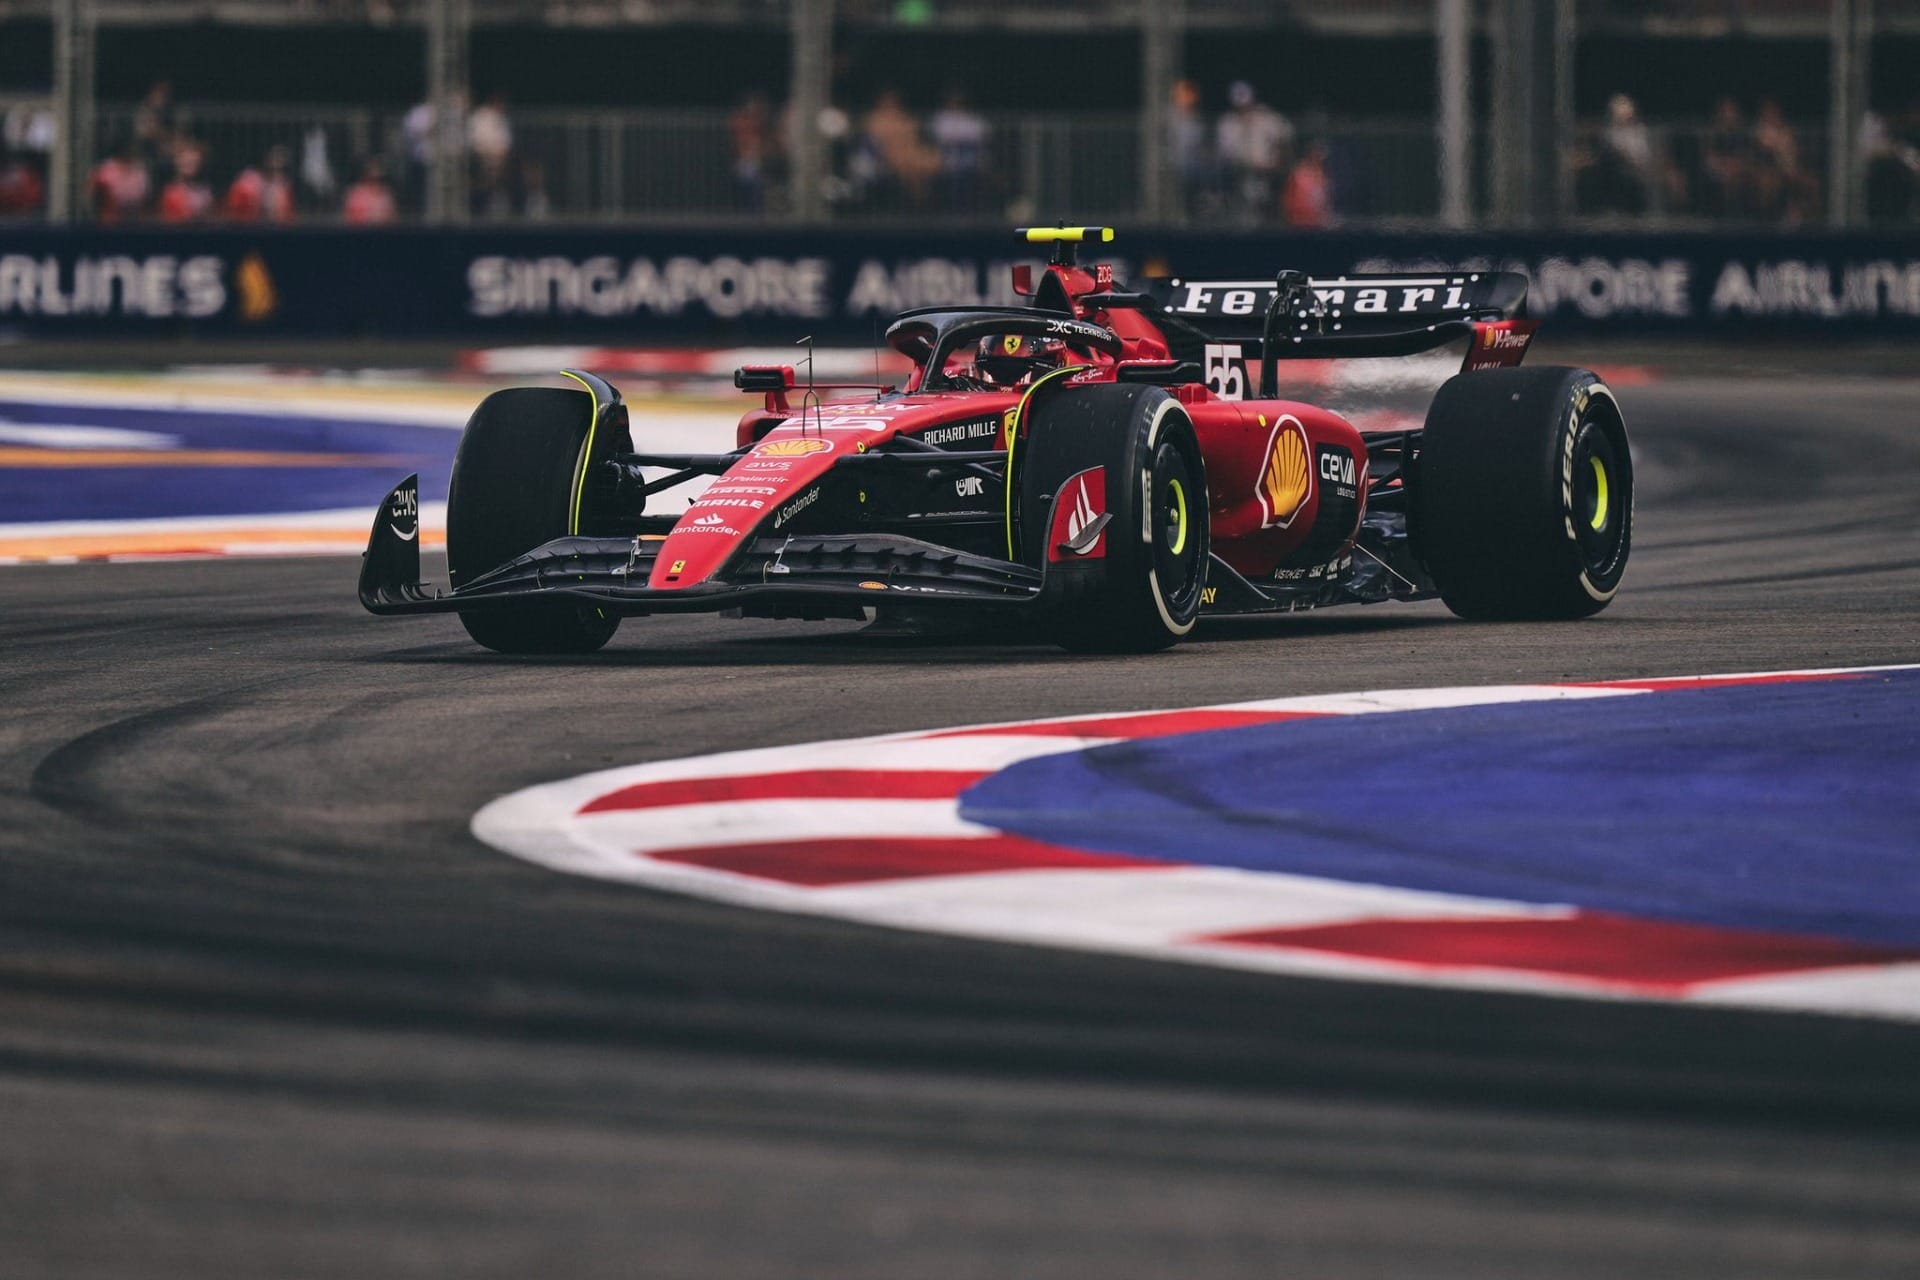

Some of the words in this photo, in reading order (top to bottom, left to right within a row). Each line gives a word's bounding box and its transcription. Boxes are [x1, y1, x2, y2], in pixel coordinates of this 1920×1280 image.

[469, 256, 828, 316] SINGAPORE
[1047, 319, 1072, 334] DXC
[1074, 325, 1112, 341] TECHNOLOGY
[1205, 344, 1242, 401] 55
[773, 416, 895, 432] 55
[924, 425, 966, 445] RICHARD
[967, 421, 997, 439] MILLE
[745, 461, 793, 469] aws
[1562, 407, 1580, 511] ZERO
[729, 476, 790, 484] Palantir
[782, 486, 820, 524] Santander
[671, 525, 741, 537] antander
